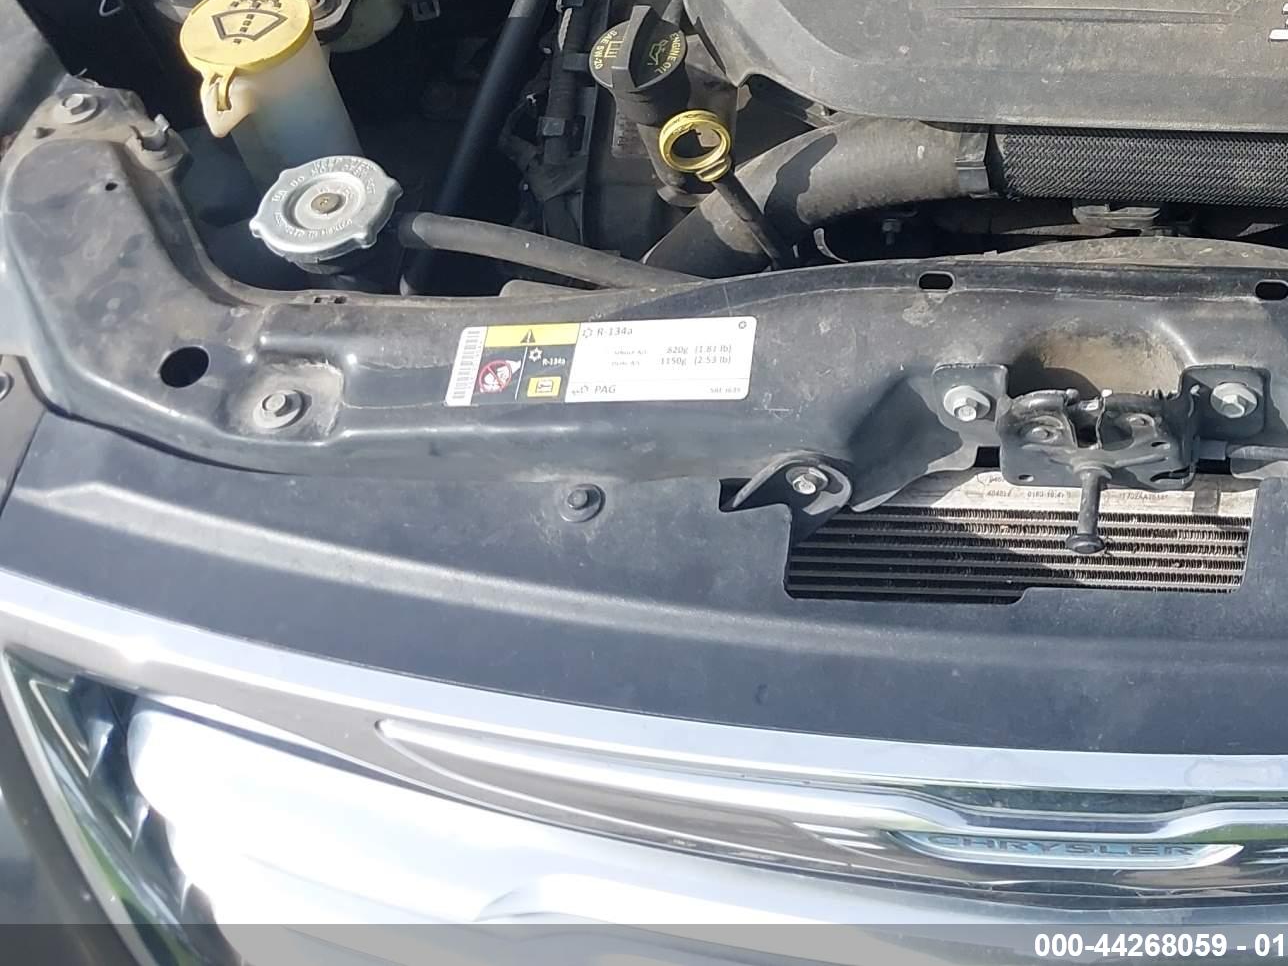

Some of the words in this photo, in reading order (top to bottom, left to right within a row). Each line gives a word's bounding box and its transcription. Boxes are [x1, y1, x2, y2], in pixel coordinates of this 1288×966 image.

[600, 30, 618, 44] SAE
[667, 32, 681, 62] ENGINE
[654, 62, 672, 75] OIL
[595, 385, 616, 394] PAG
[927, 834, 1195, 856] CHRYSLER
